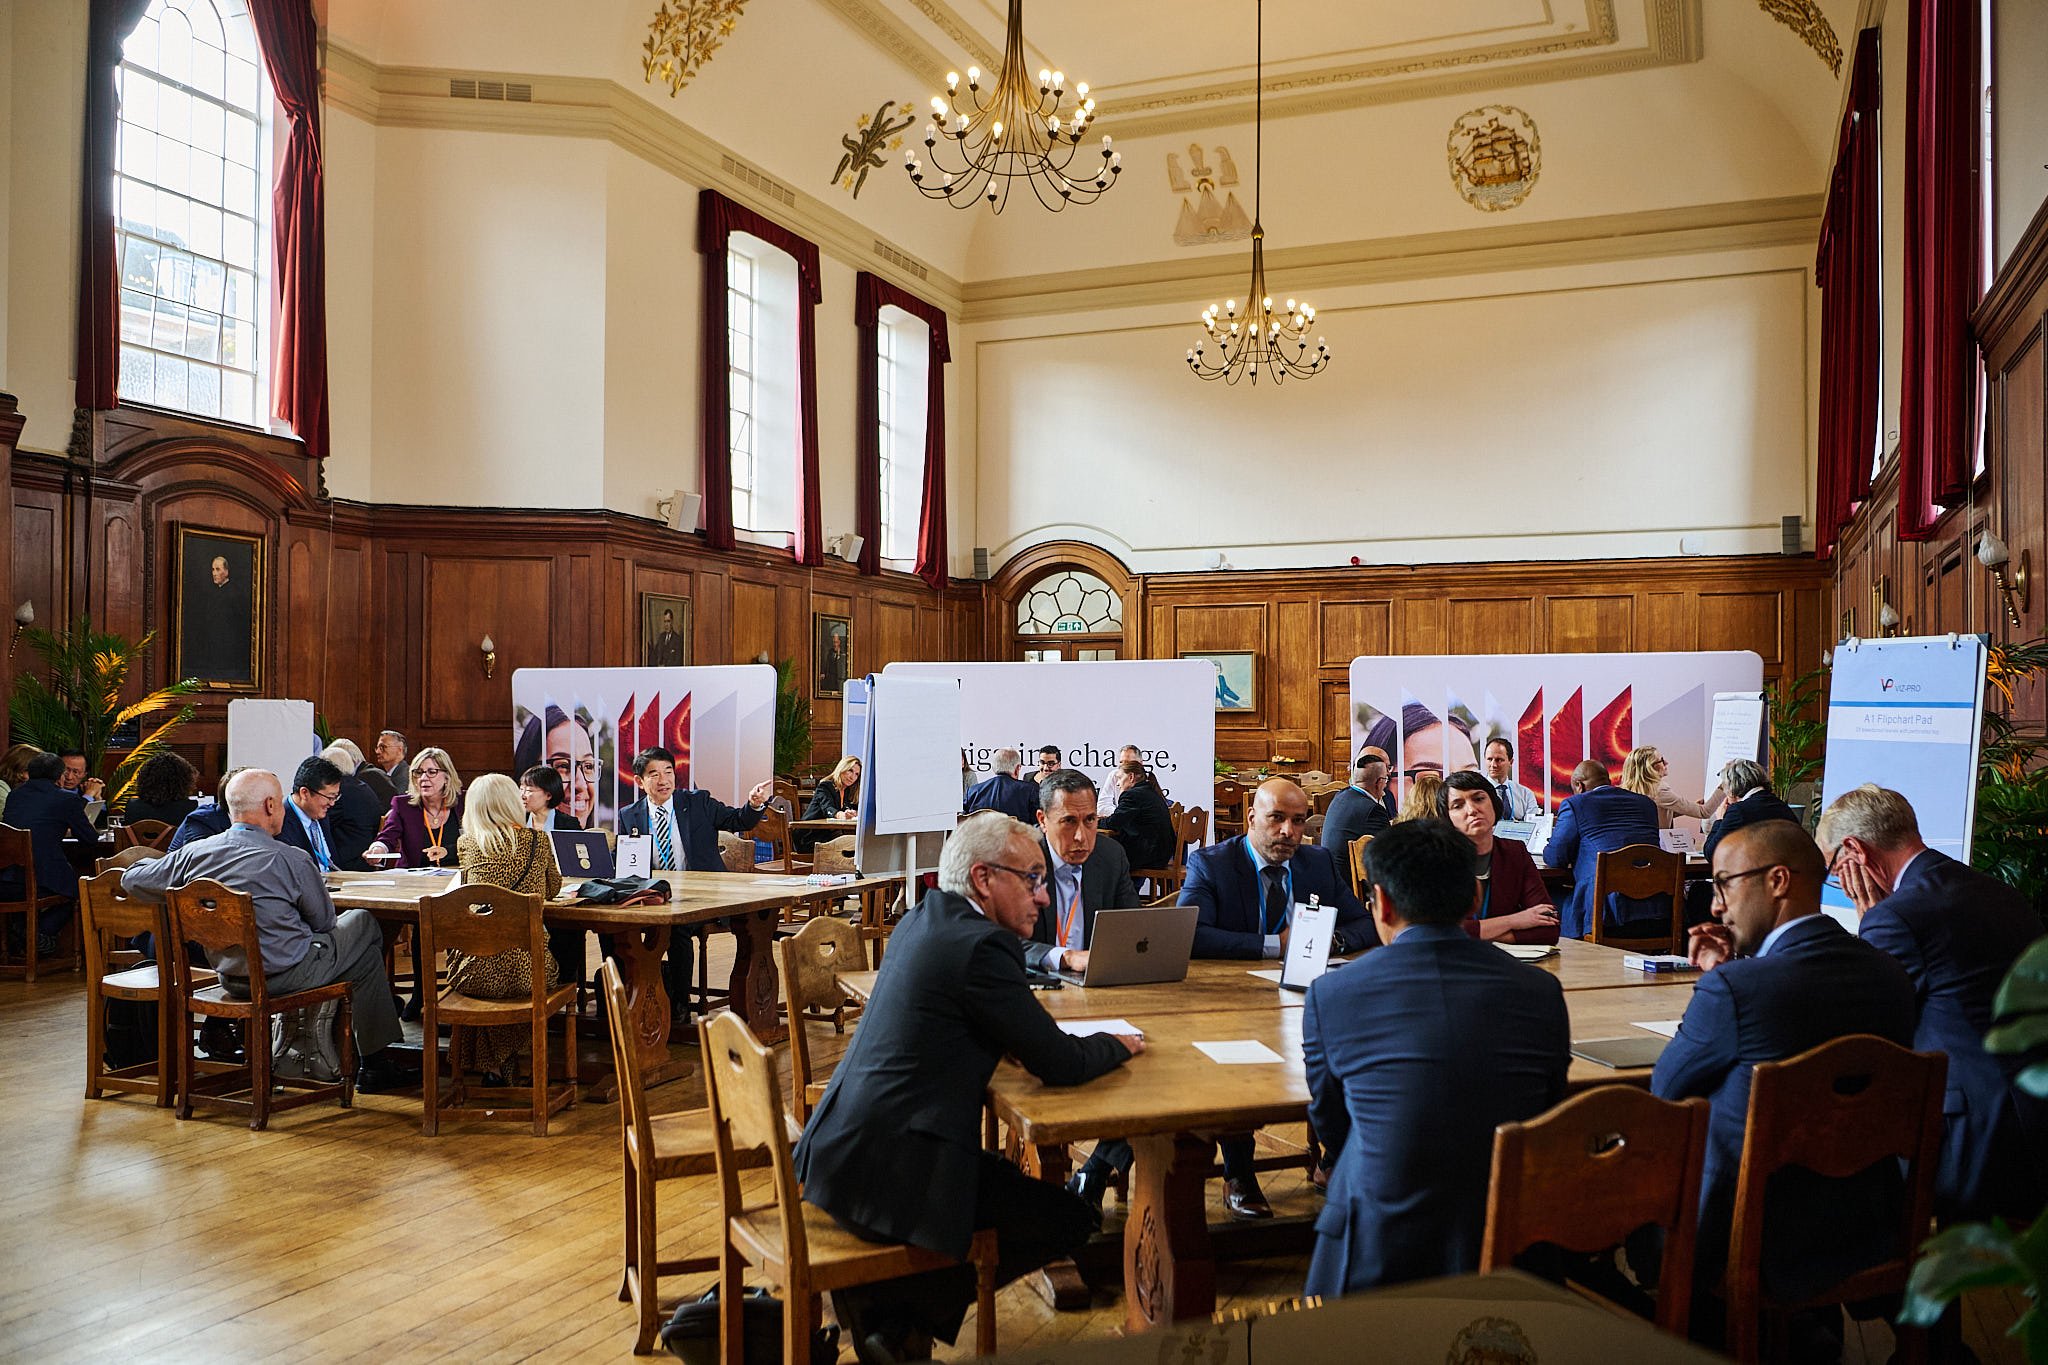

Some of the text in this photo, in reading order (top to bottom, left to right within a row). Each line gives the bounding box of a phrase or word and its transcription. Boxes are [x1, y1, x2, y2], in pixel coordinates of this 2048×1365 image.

[1915, 714, 1933, 725] Pad
[1068, 742, 1177, 774] chage,
[630, 853, 637, 864] 3
[1304, 937, 1314, 954] 4
